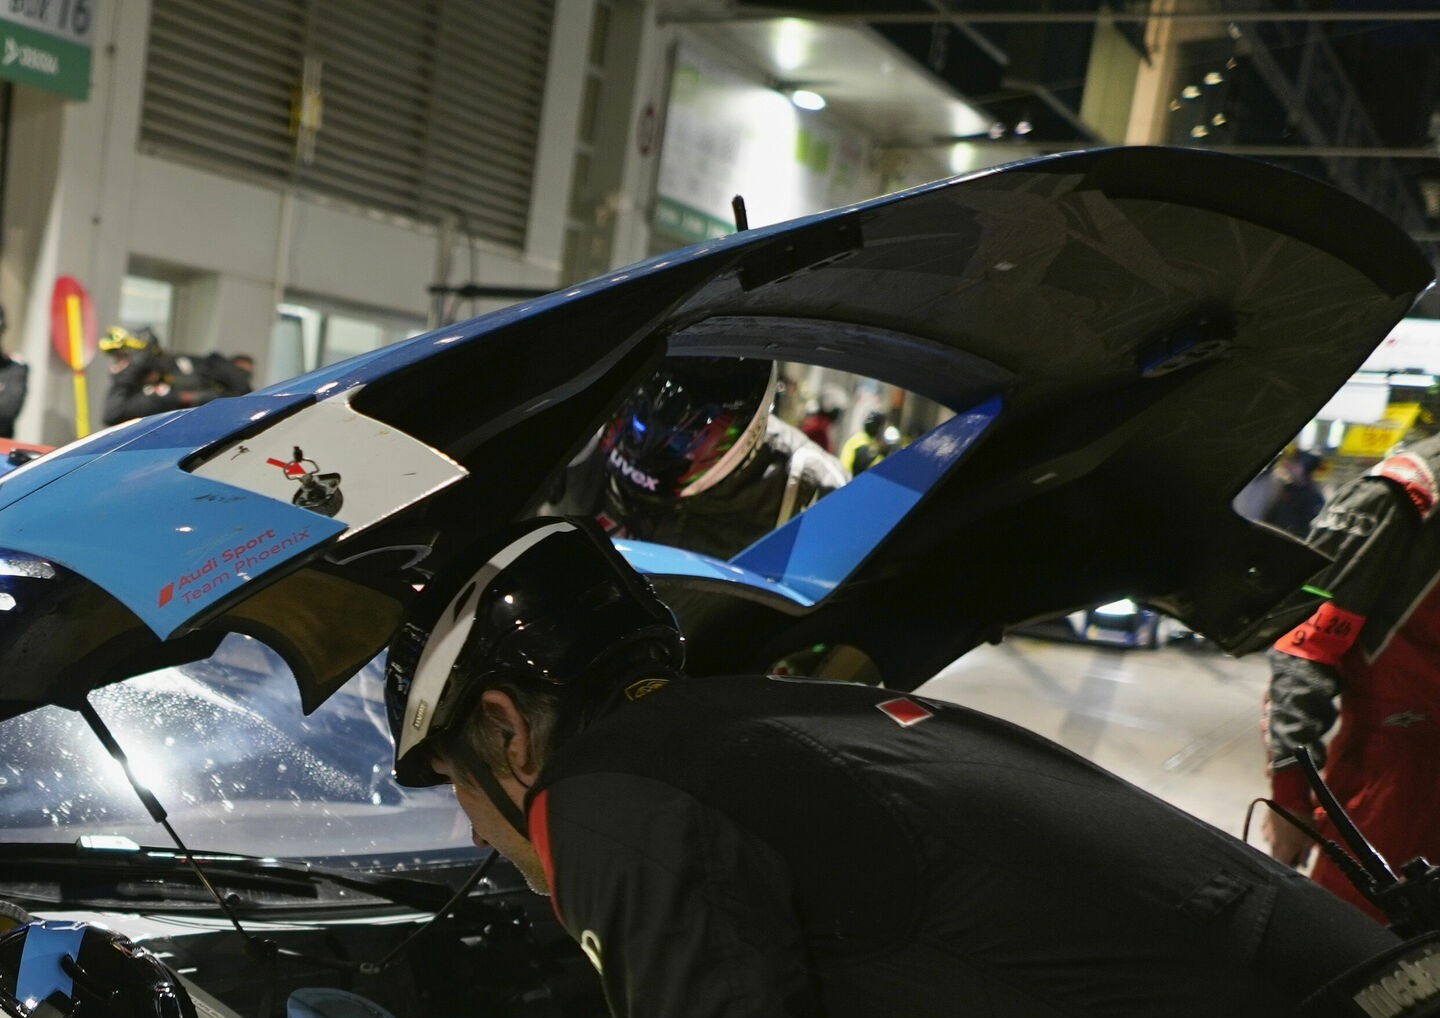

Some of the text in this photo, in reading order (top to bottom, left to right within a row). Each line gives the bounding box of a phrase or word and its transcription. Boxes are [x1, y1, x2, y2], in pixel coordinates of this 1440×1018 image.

[610, 447, 659, 492] uvex
[178, 528, 277, 590] Audi Sport
[182, 528, 311, 605] Team Phoenix
